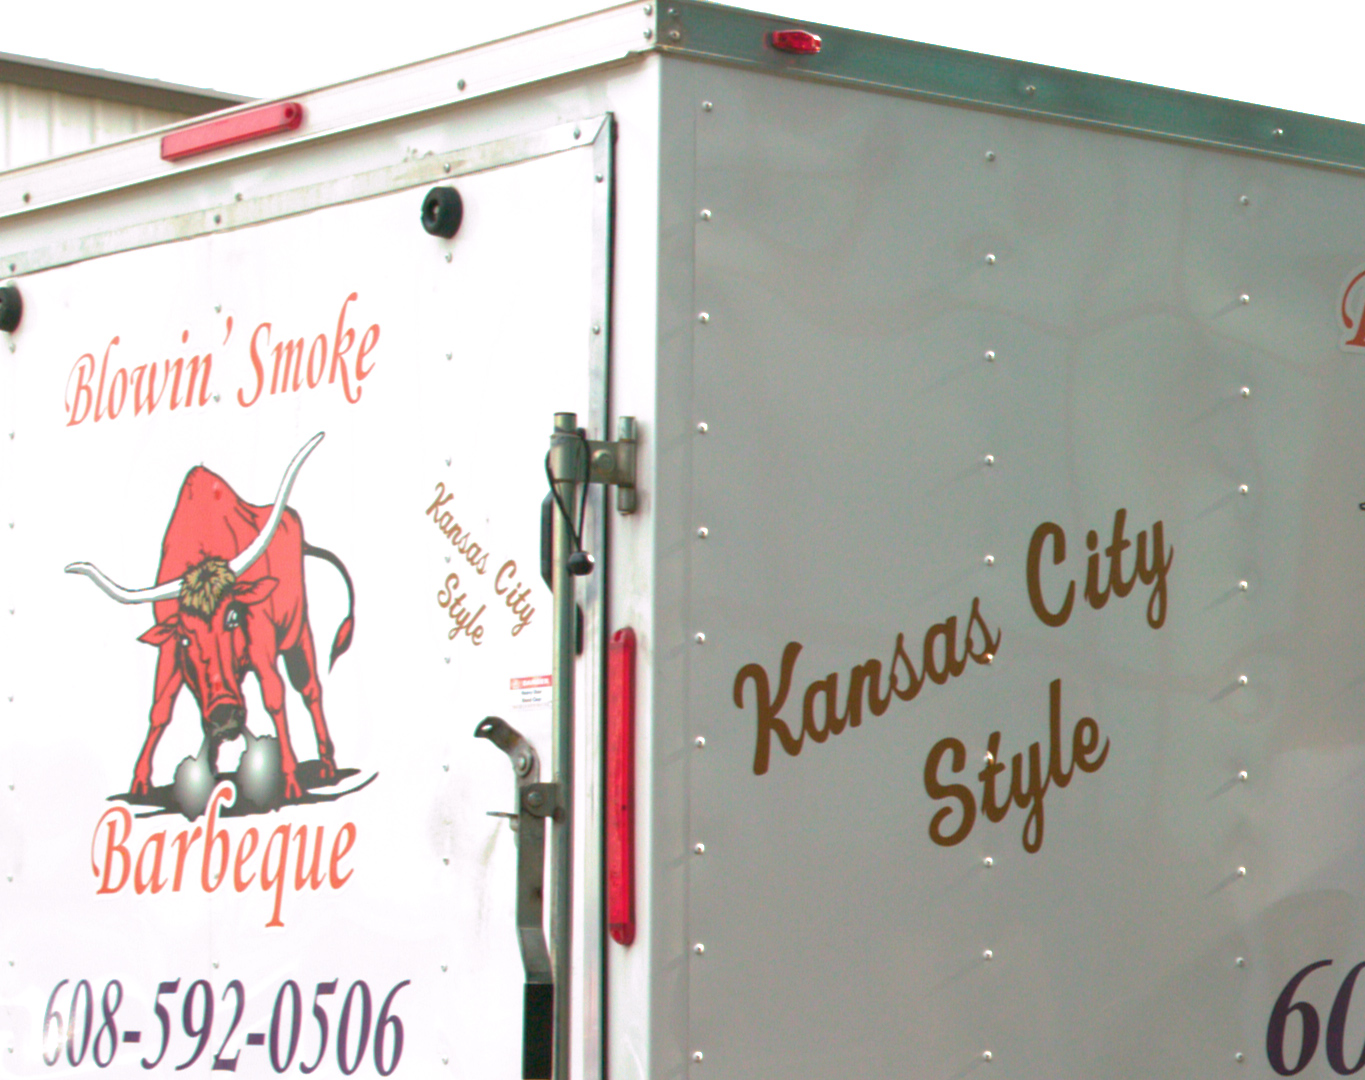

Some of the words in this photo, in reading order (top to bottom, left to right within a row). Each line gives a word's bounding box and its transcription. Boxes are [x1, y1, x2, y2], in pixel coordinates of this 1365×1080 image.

[65, 316, 233, 427] Blowin'
[236, 292, 381, 408] Smoke
[426, 481, 490, 575] Kansas
[494, 559, 536, 637] City
[437, 572, 487, 646] Style
[732, 596, 1001, 776] Kansas
[1026, 508, 1174, 630] City
[923, 678, 1110, 854] Style
[91, 786, 357, 929] Barbeque
[42, 978, 412, 1077] 608-592-0506
